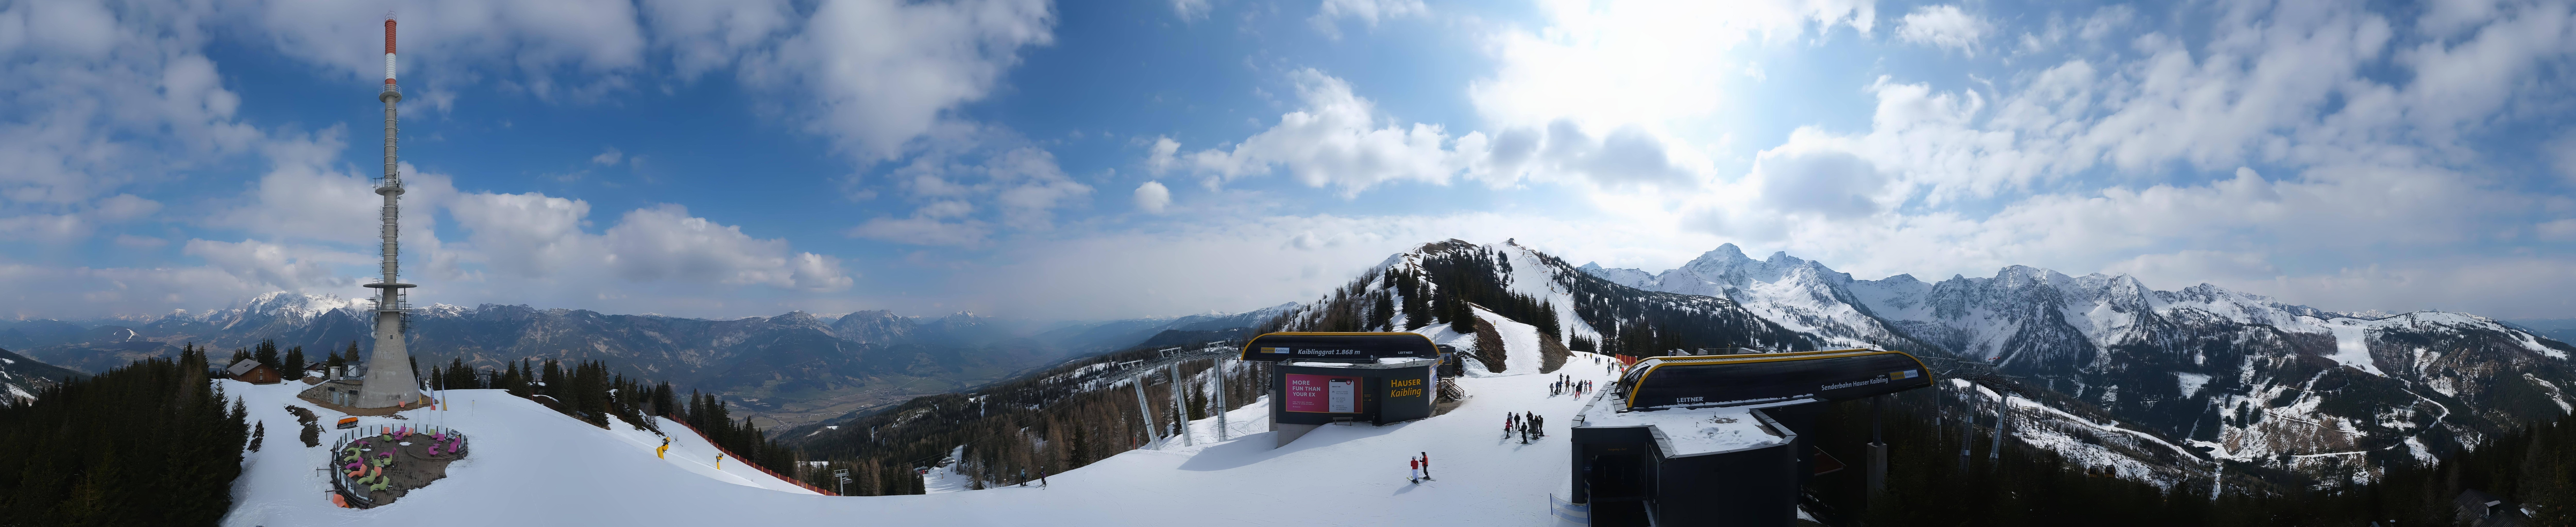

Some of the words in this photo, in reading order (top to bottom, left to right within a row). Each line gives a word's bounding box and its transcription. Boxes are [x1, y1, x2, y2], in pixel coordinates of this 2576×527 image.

[1391, 379, 1421, 387] HAUSER
[1821, 382, 1852, 391] Senderbahn
[1391, 388, 1421, 397] Kaibling
